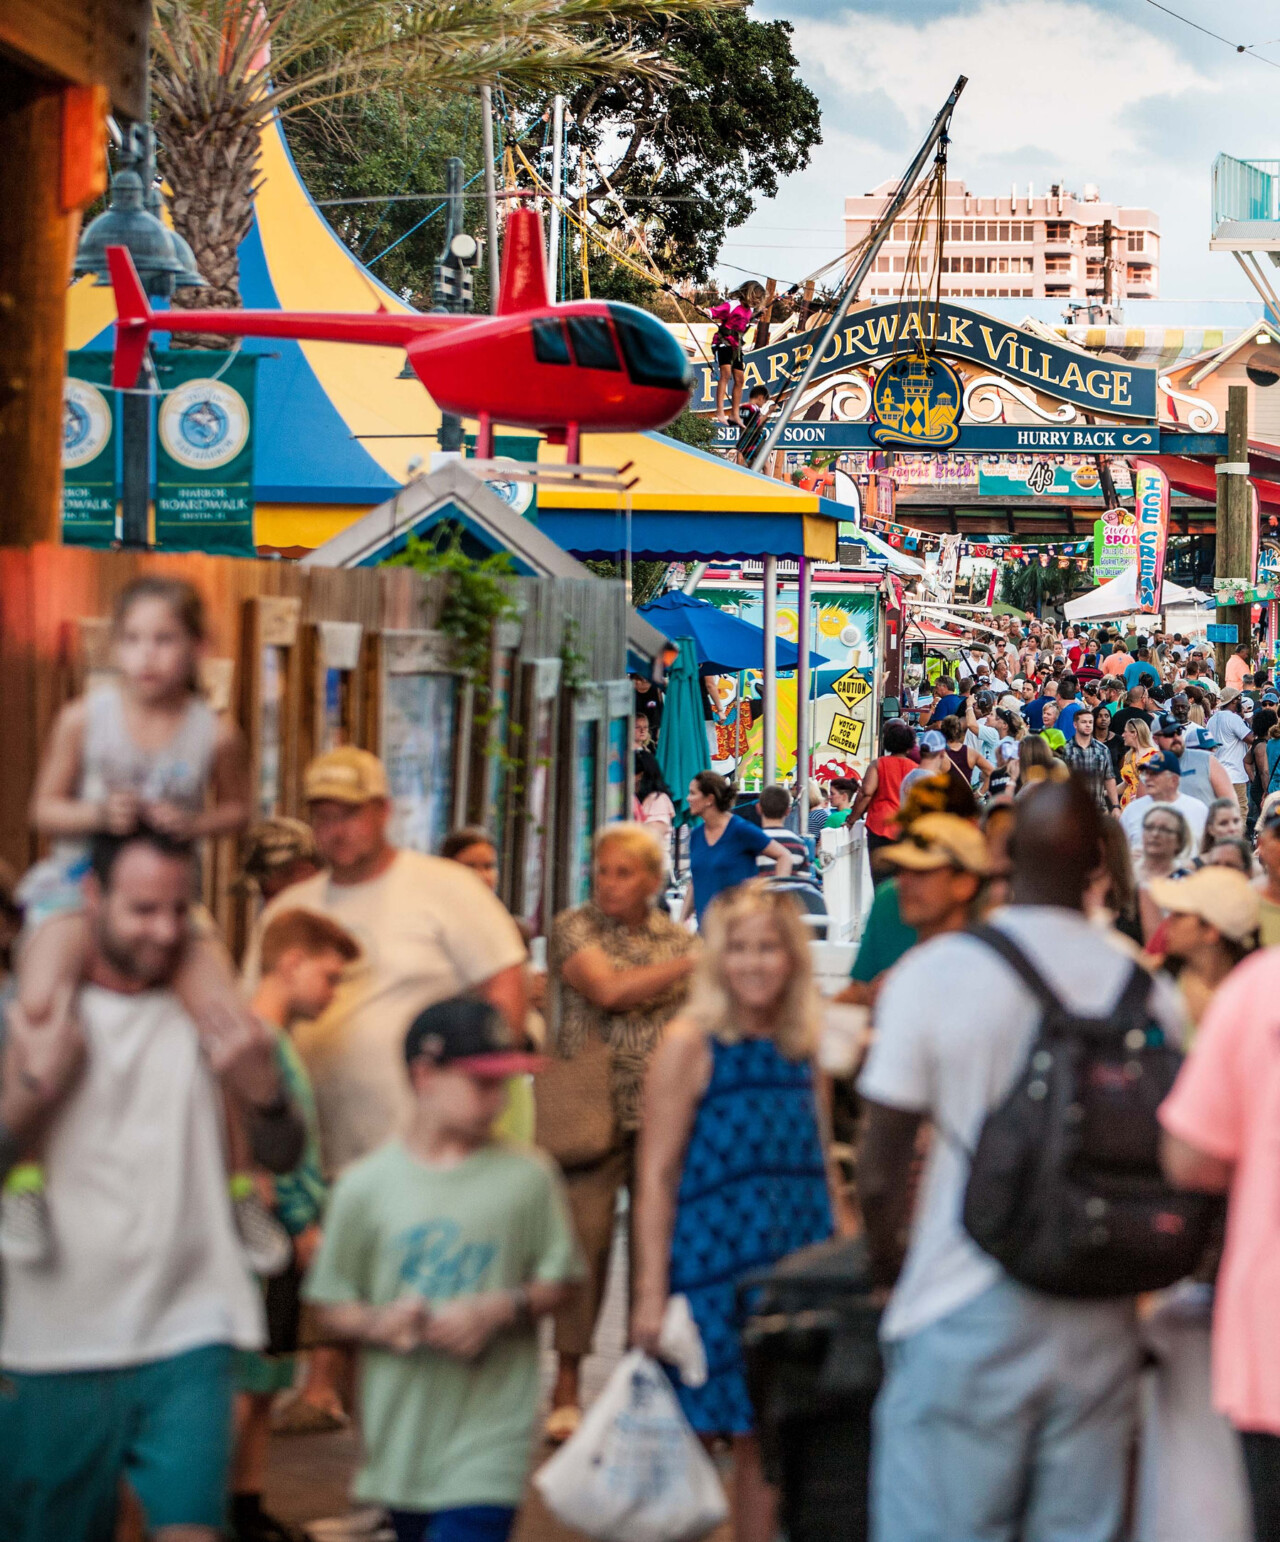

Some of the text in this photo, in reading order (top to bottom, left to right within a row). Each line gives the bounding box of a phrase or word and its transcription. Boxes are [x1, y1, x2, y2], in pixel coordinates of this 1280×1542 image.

[979, 324, 1132, 406] VILLAGE
[784, 428, 826, 441] SOON
[1017, 431, 1116, 446] HURRY BACK
[178, 487, 227, 497] HARBOR
[159, 498, 248, 510] BOARDWALK
[1141, 476, 1161, 525] ICE
[837, 681, 867, 695] CAUTION
[839, 719, 857, 731] WATCH
[840, 729, 851, 739] FOR
[830, 734, 856, 750] CHILDREN
